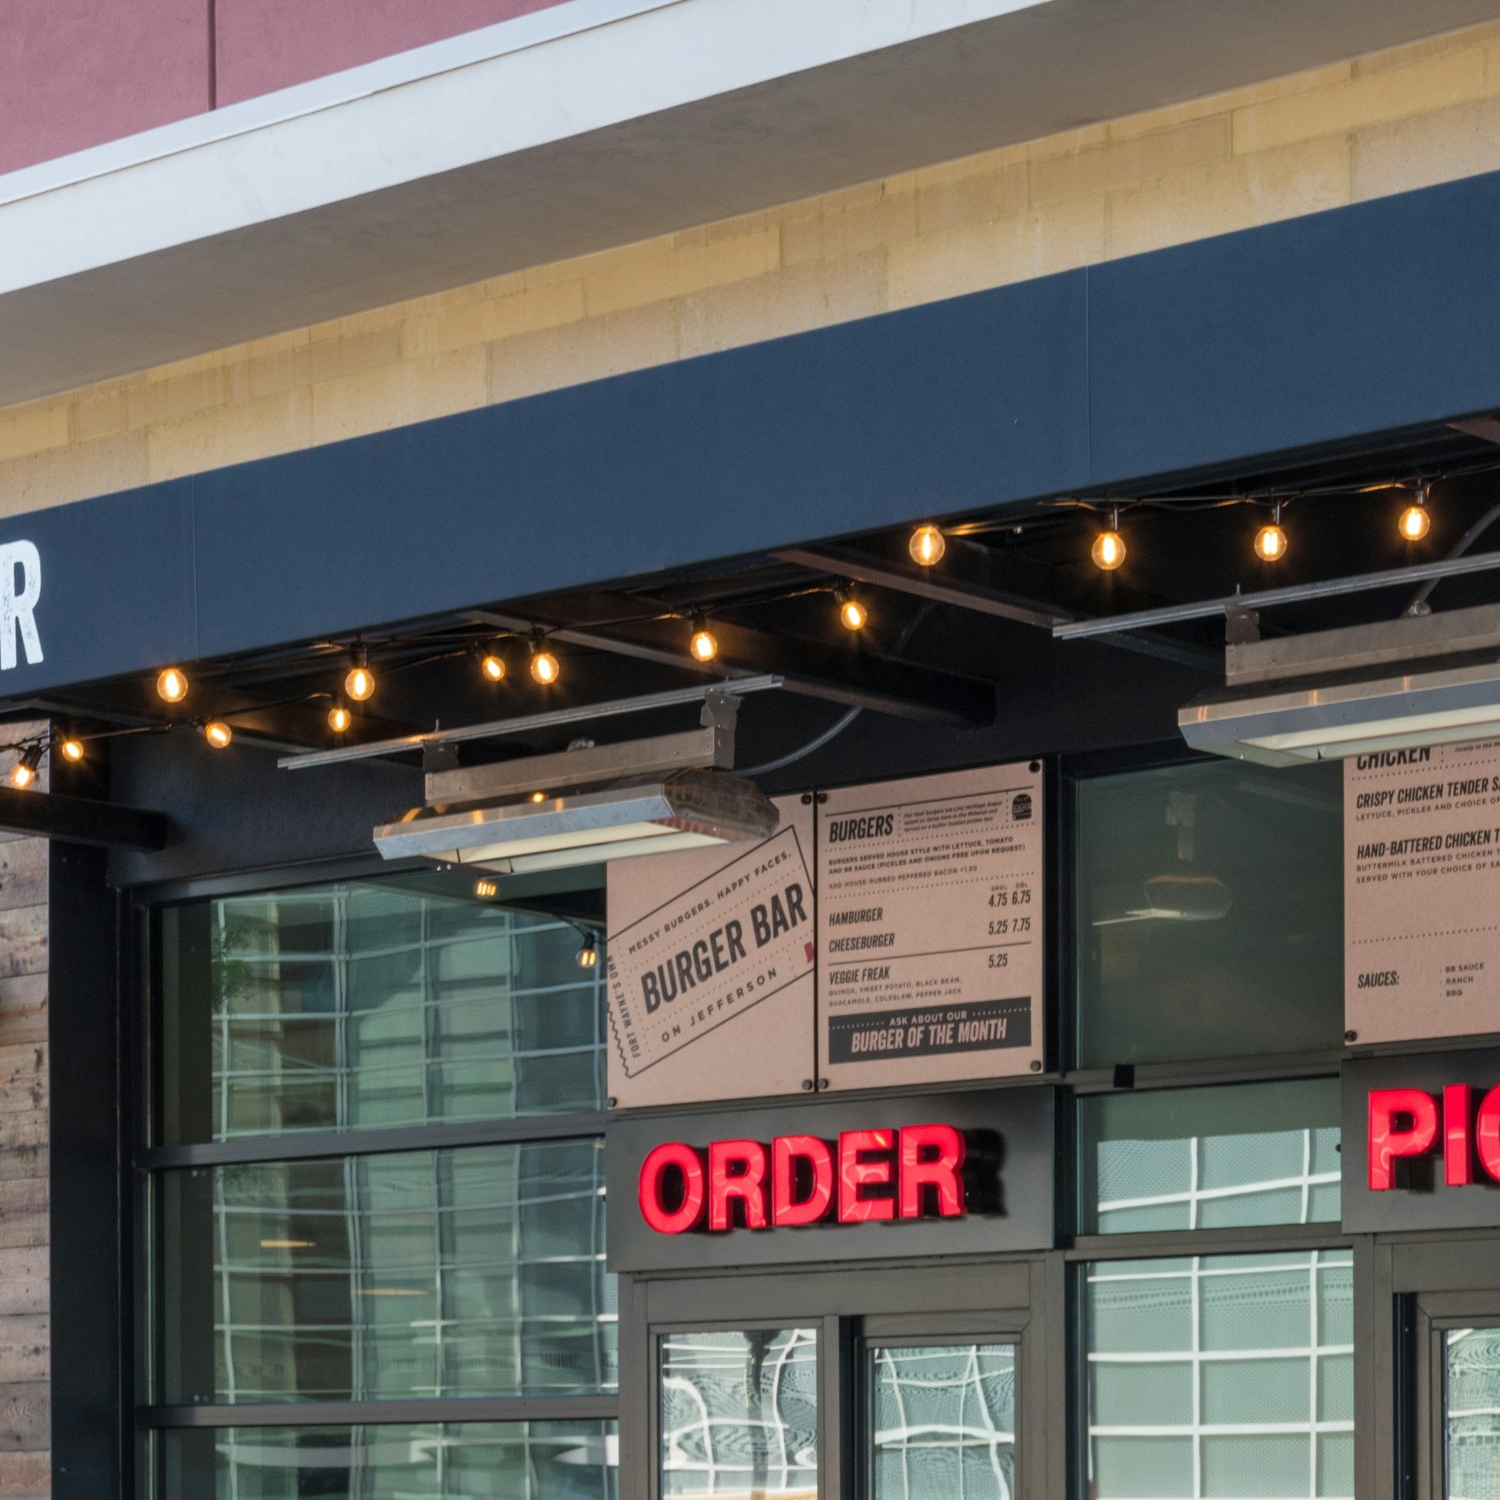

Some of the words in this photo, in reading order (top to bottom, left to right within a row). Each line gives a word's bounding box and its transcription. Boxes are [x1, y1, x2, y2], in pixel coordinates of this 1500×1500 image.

[1357, 747, 1431, 771] CHICKEN
[1357, 790, 1395, 809] CRISPY
[1397, 784, 1444, 804] CHICKEN
[1447, 778, 1489, 797] TENDER
[1397, 805, 1431, 816] PICKLES
[1434, 802, 1452, 811] AND
[1455, 798, 1486, 809] CHOICE
[1490, 796, 1500, 804] OF
[829, 814, 894, 843] BURGERS
[986, 836, 1013, 845] TOMATO
[1357, 835, 1442, 859] HAND-BATTERED
[1445, 829, 1491, 849] CHICKEN
[1356, 860, 1406, 872] BUTTERMILK
[1410, 854, 1453, 866] BATTERED
[1456, 850, 1493, 860] CHICKEN
[1356, 874, 1388, 884] SERVED
[1391, 871, 1412, 880] WITH
[1416, 868, 1438, 876] YOUR
[1440, 864, 1472, 874] CHOICE
[1476, 862, 1486, 870] OF
[629, 930, 661, 954] MESSY
[664, 899, 715, 933] BURGERS.
[717, 873, 750, 900] HAPPY
[754, 852, 791, 877] FACES.
[829, 908, 883, 926] HAMBURGER
[988, 919, 1008, 935] 5.25
[1013, 917, 1031, 932] 7.75
[641, 919, 746, 1014] BURGER
[750, 883, 807, 949] BAR
[829, 933, 895, 953] CHEESEBURGER
[988, 953, 1008, 969] 5.25
[1458, 963, 1484, 972] SAUCE
[830, 969, 859, 985] VEGGIE
[862, 966, 890, 982] FREAK
[860, 985, 882, 993] SWEET
[916, 979, 938, 987] BLACK
[1358, 971, 1400, 989] SAUCES:
[1446, 976, 1473, 984] RANCH
[916, 990, 942, 998] PEPPER
[945, 988, 961, 996] JACK
[612, 982, 632, 1029] WAYNE'S
[662, 1025, 681, 1043] ON
[690, 968, 777, 1027] JEFFERSON
[889, 1016, 907, 1026] ASK
[911, 1013, 943, 1024] ABOUT
[947, 1011, 967, 1021] OUR
[627, 1032, 641, 1058] FORT
[852, 1028, 904, 1053] BURGER
[907, 1026, 925, 1048] OF
[929, 1023, 954, 1045] THE
[958, 1018, 1007, 1043] MONTH
[638, 1124, 965, 1235] ORDER
